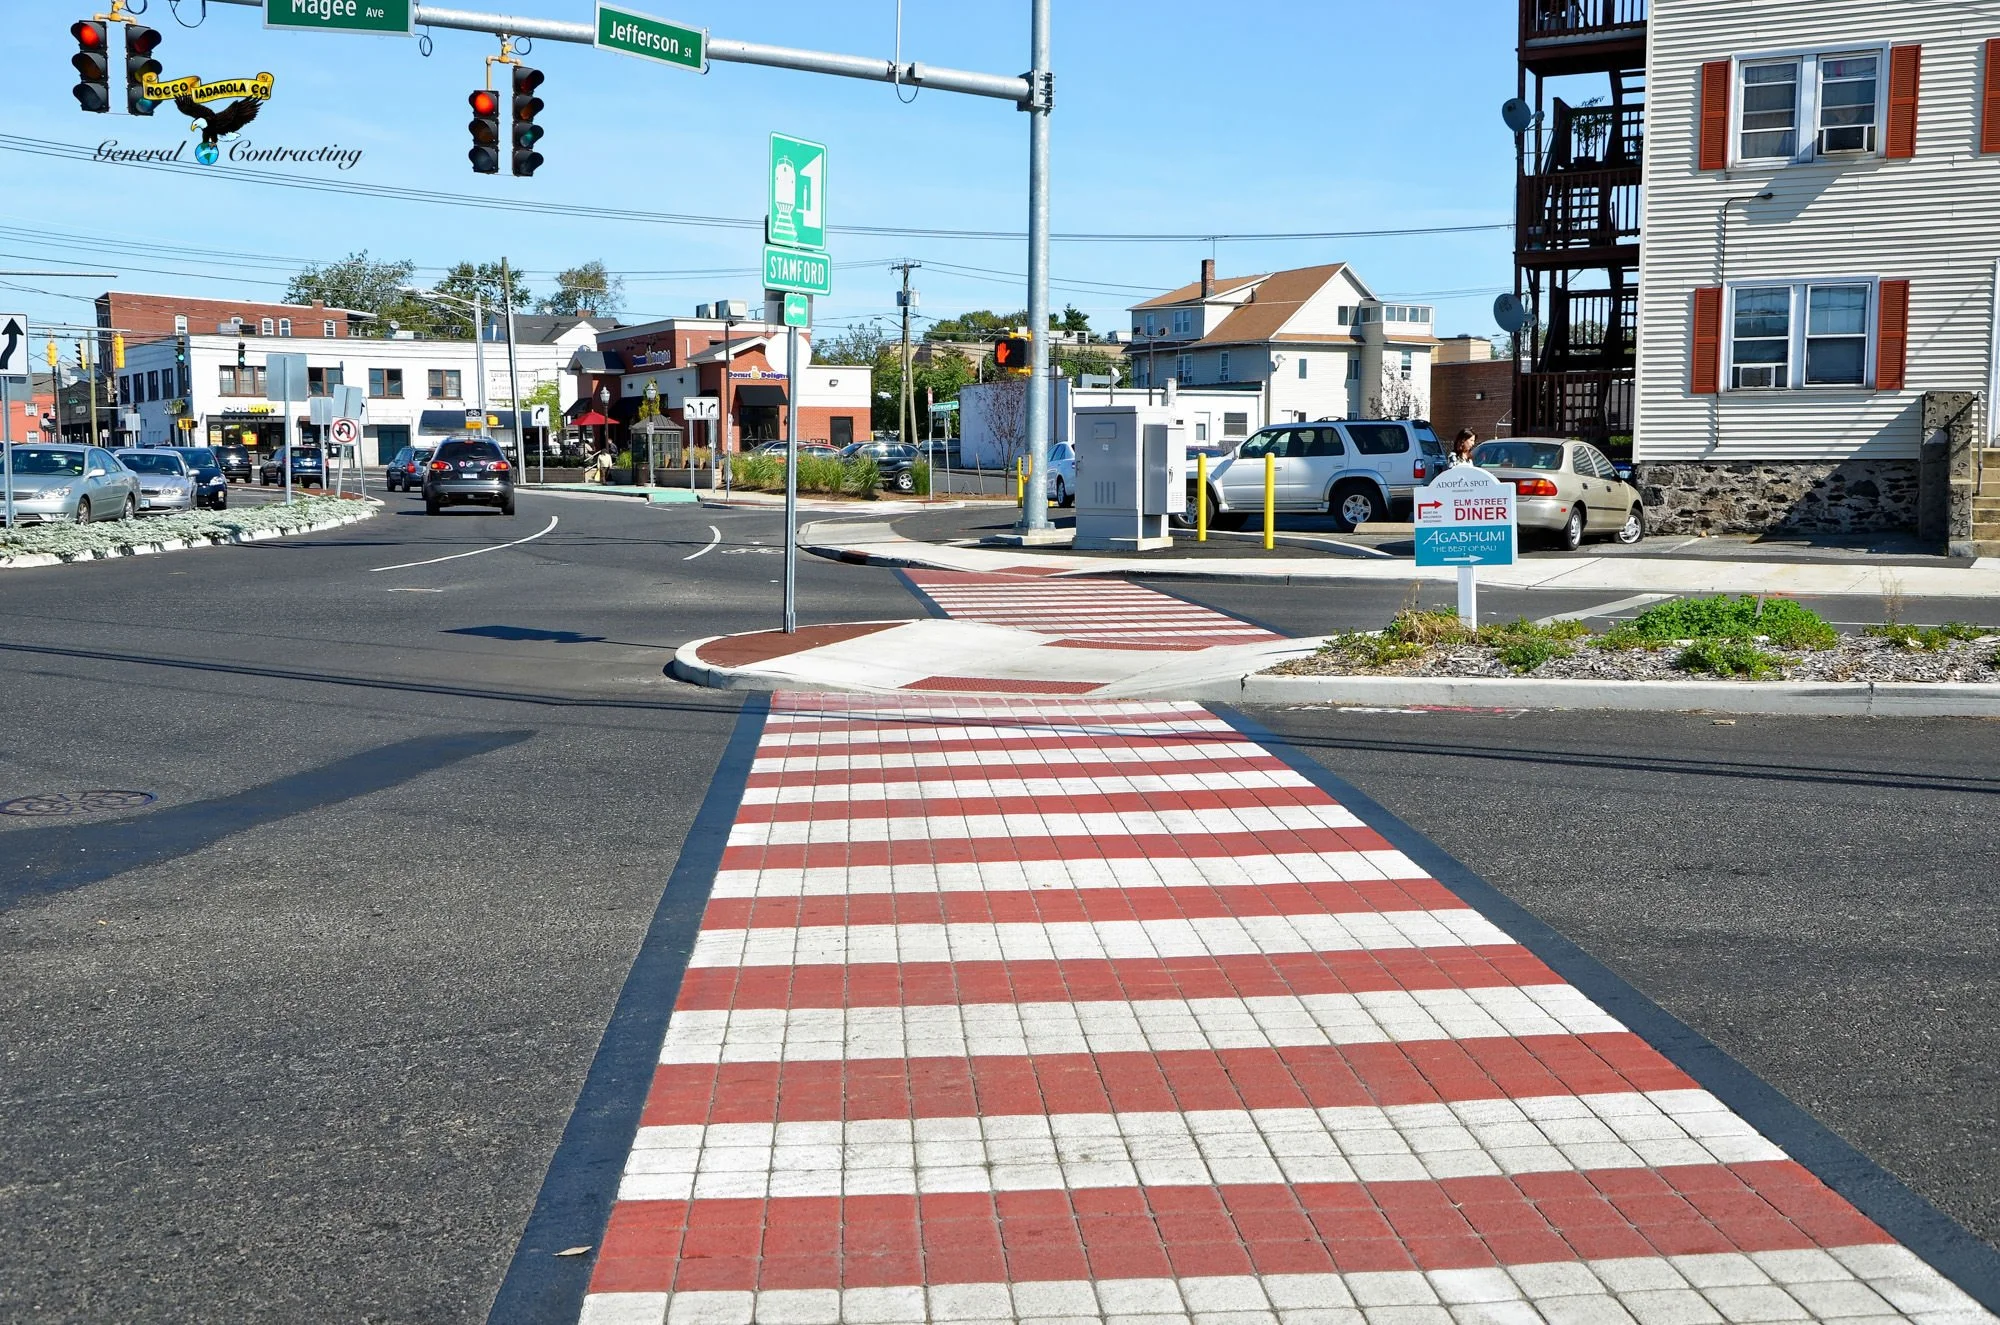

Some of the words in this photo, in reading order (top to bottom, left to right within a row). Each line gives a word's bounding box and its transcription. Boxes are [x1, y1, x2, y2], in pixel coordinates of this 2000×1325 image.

[291, 0, 357, 20] Magee
[365, 7, 385, 18] Ave
[609, 20, 679, 55] Jefferson
[684, 47, 692, 58] St
[770, 255, 825, 285] STAMFORD
[1436, 480, 1462, 488] ADOPT
[1473, 497, 1508, 506] STREET
[1455, 506, 1508, 521] DINER
[1423, 530, 1505, 545] AGABHUMI
[1432, 545, 1447, 553] THE
[1447, 545, 1467, 553] BEST
